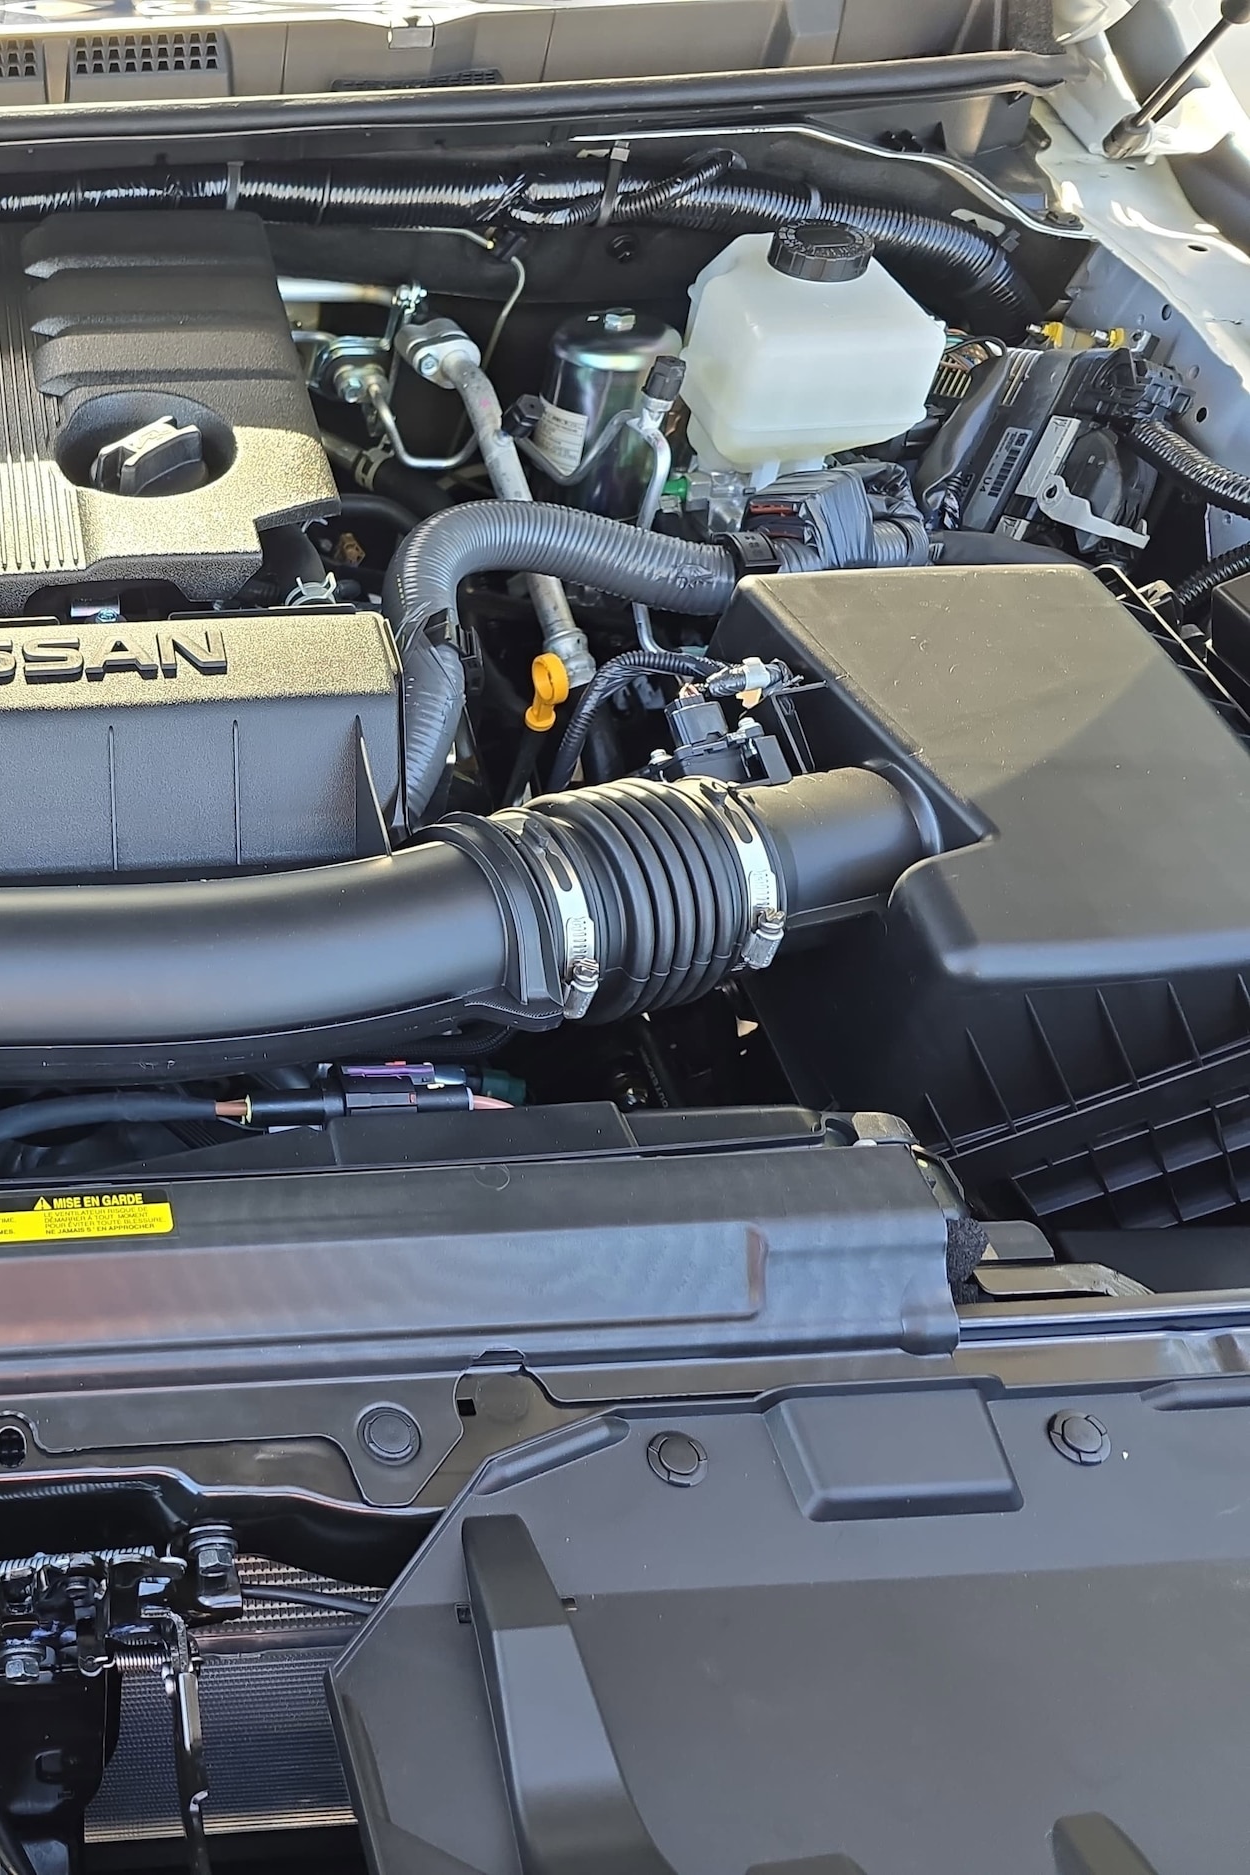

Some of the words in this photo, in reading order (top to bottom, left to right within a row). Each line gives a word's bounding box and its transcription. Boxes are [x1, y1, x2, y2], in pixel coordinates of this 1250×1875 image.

[52, 1197, 82, 1209] MISE
[83, 1195, 100, 1207] EN
[102, 1193, 143, 1206] GARDE
[55, 1208, 106, 1217] VENTILATEUR
[117, 1211, 148, 1219] MOMENT
[57, 1226, 85, 1234] JAMAIS
[108, 1223, 155, 1231] APPROCHER
